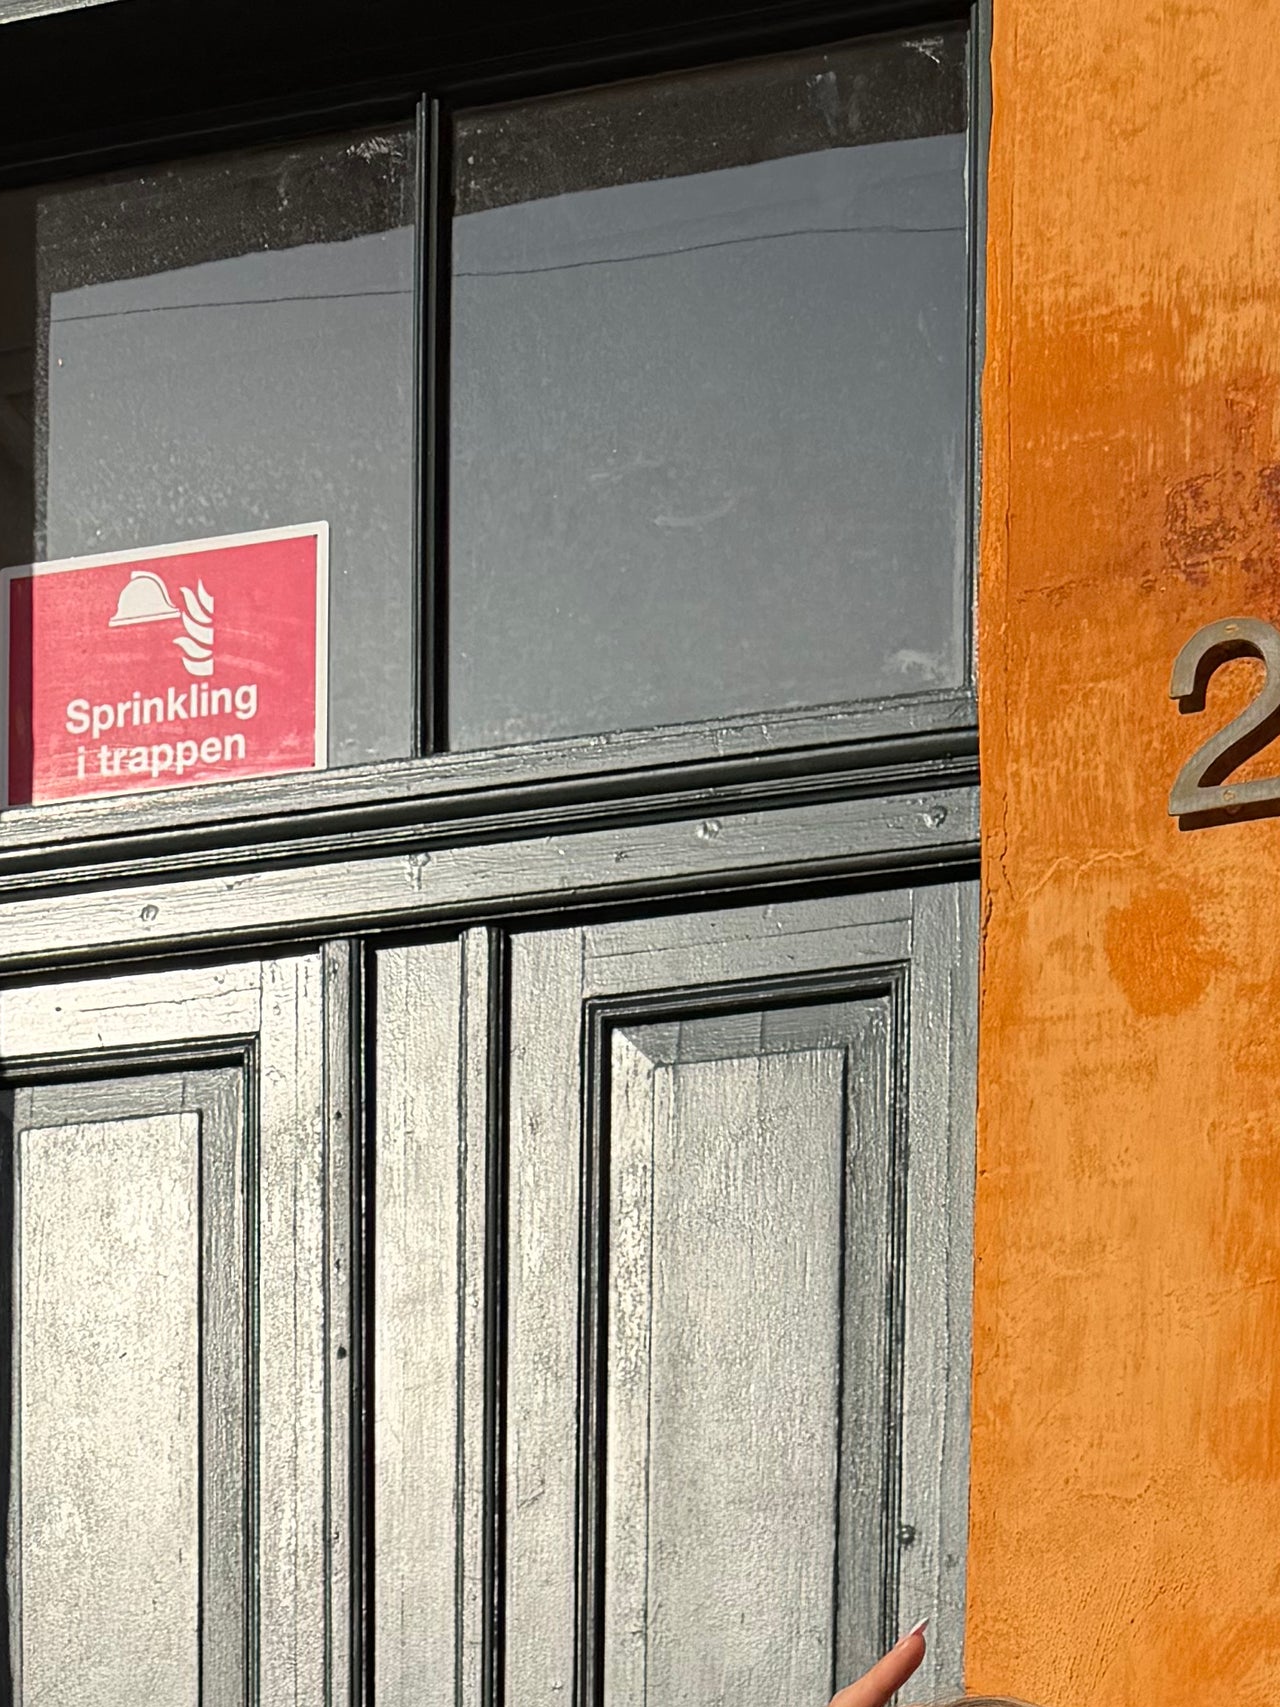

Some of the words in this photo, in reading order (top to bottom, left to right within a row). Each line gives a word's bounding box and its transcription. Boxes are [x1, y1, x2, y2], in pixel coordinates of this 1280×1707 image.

[66, 682, 257, 739] Sprinkling
[77, 747, 86, 779] i
[99, 733, 245, 778] trappen
